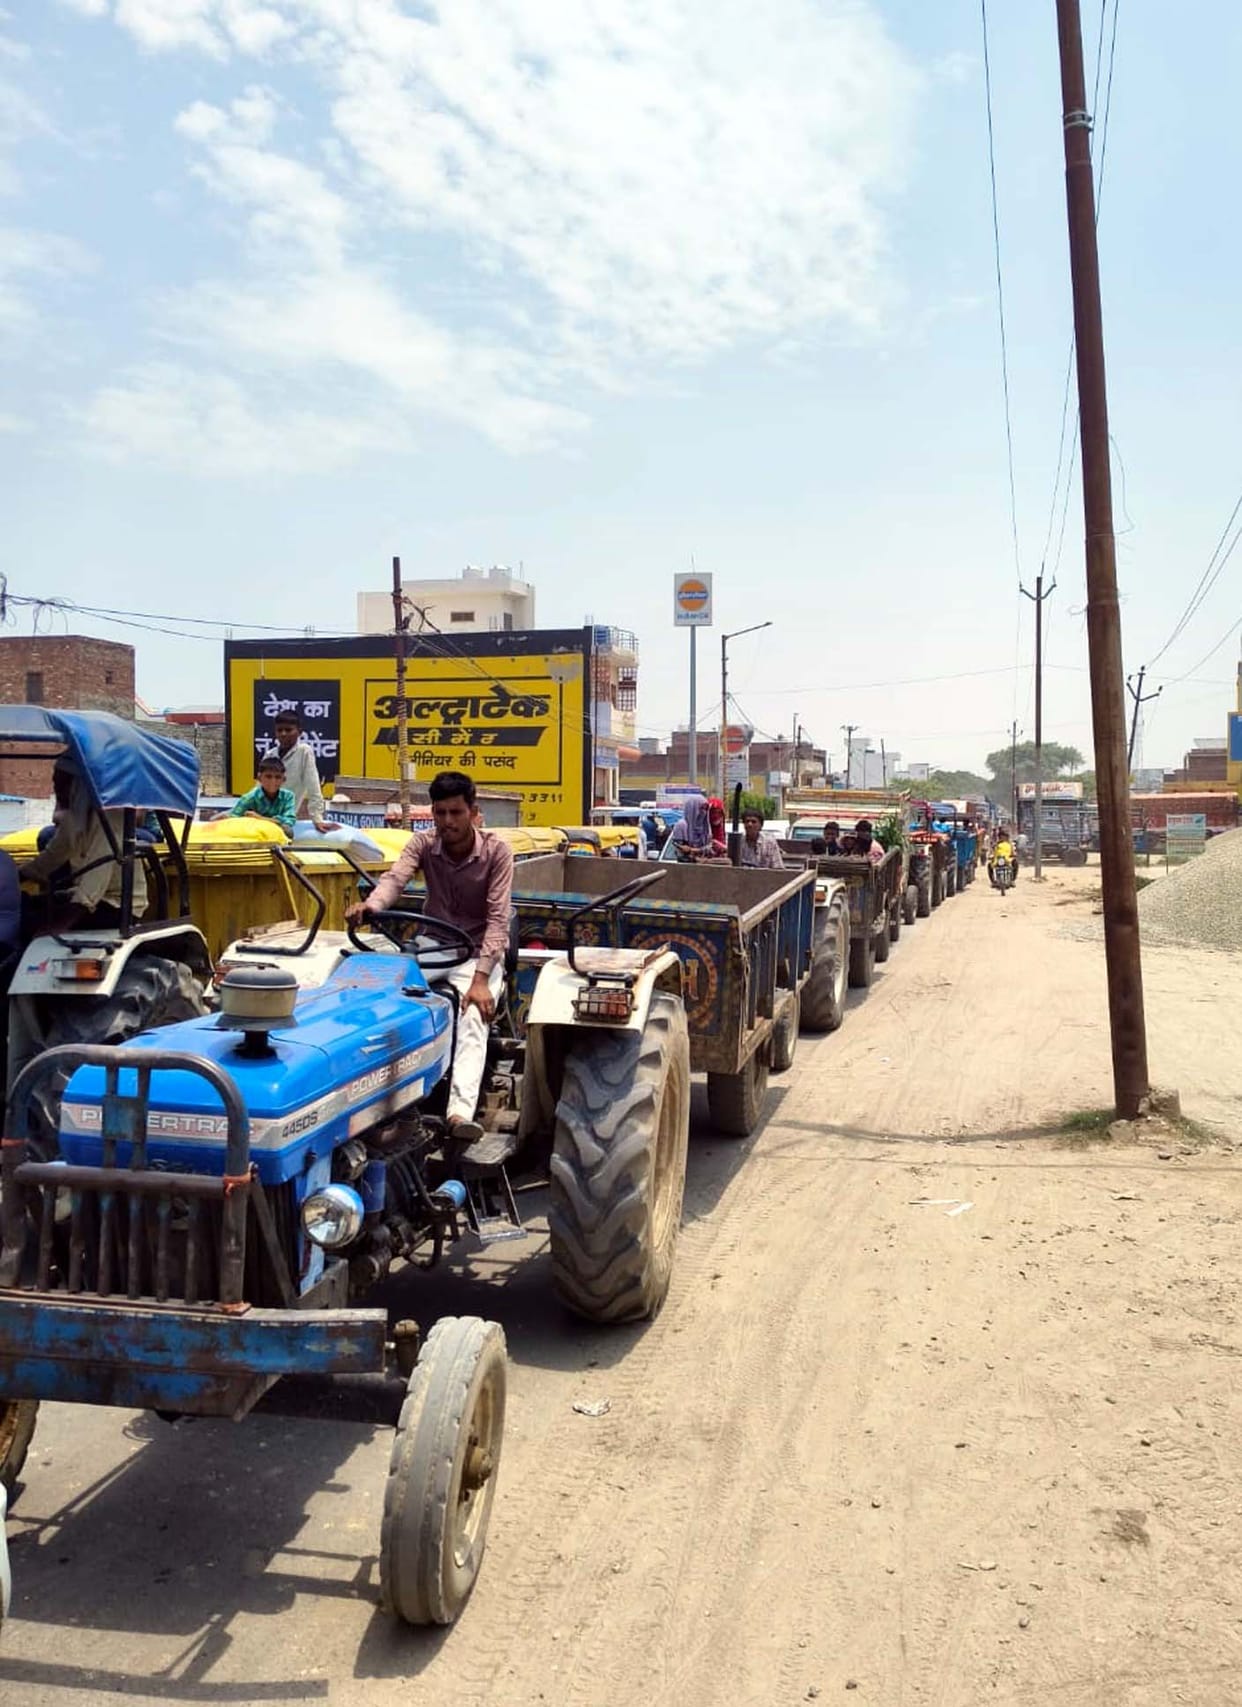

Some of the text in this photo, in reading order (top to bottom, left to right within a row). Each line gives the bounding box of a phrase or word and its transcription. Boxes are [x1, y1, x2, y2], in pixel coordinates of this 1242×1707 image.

[303, 701, 332, 718] का
[459, 751, 476, 767] की
[482, 751, 518, 769] पसंद
[81, 1109, 255, 1135] PERTRA
